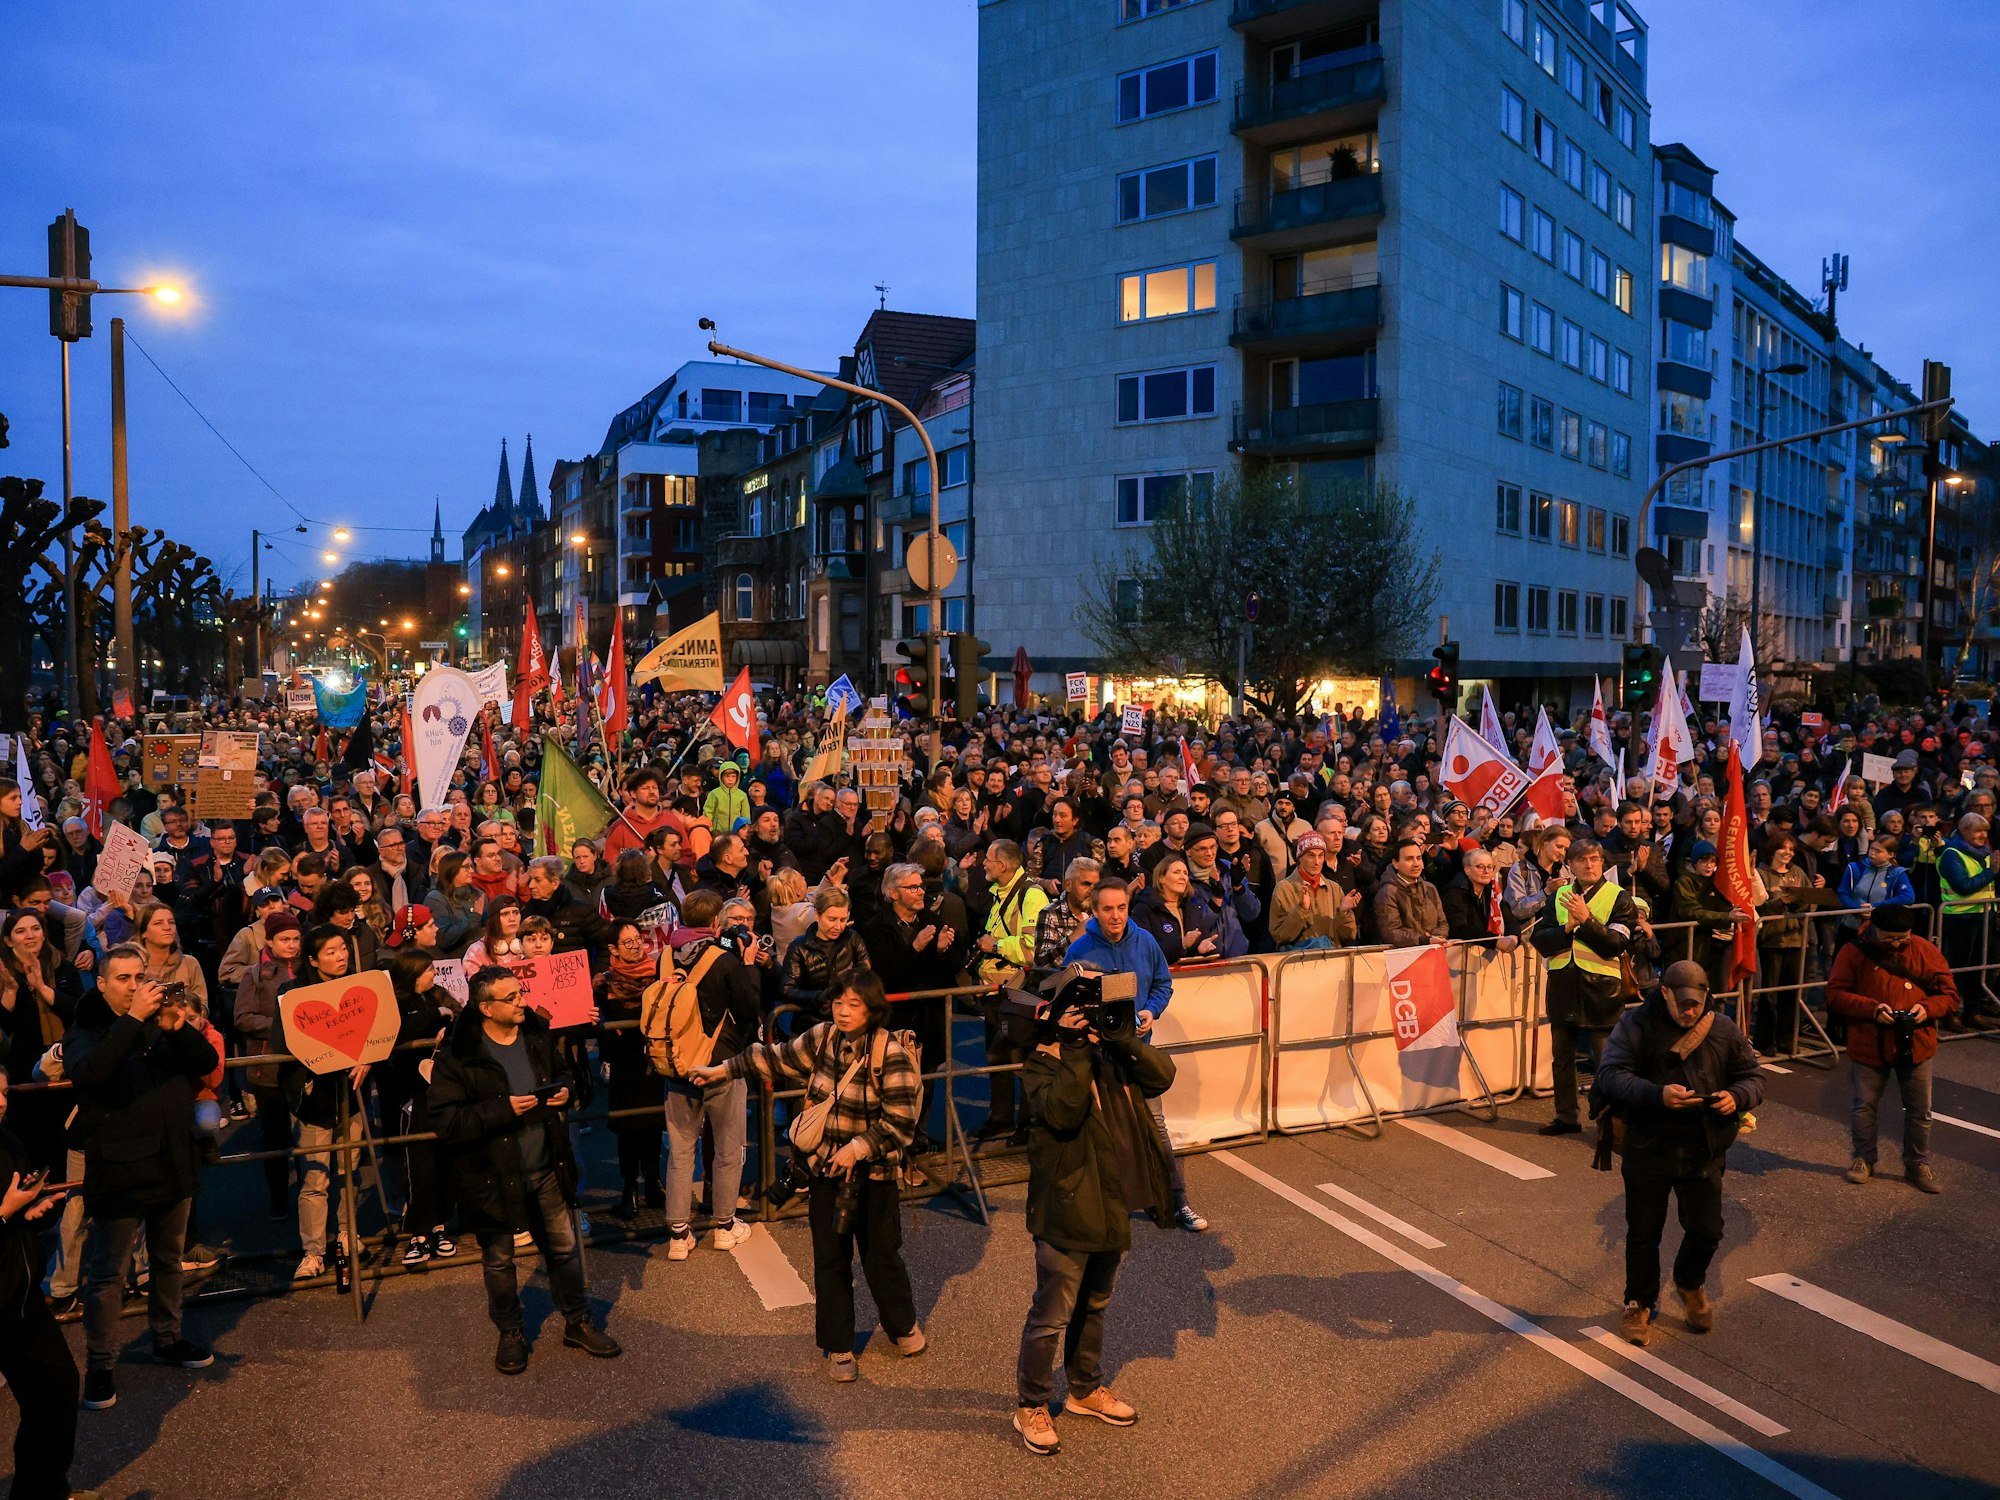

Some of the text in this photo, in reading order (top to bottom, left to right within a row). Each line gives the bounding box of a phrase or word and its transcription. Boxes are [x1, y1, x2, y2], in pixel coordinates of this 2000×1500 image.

[1070, 679, 1084, 687] FCK
[290, 692, 311, 702] Unser
[1125, 720, 1140, 728] NZS
[1126, 711, 1140, 720] FCK
[1725, 815, 1748, 900] GEMEINSAM
[119, 858, 142, 893] HASS!
[549, 955, 584, 974] WAREN
[552, 972, 577, 990] 1933
[326, 1007, 365, 1028] RECHTE
[1391, 980, 1420, 1038] DGB
[304, 1050, 336, 1068] RECHTE
